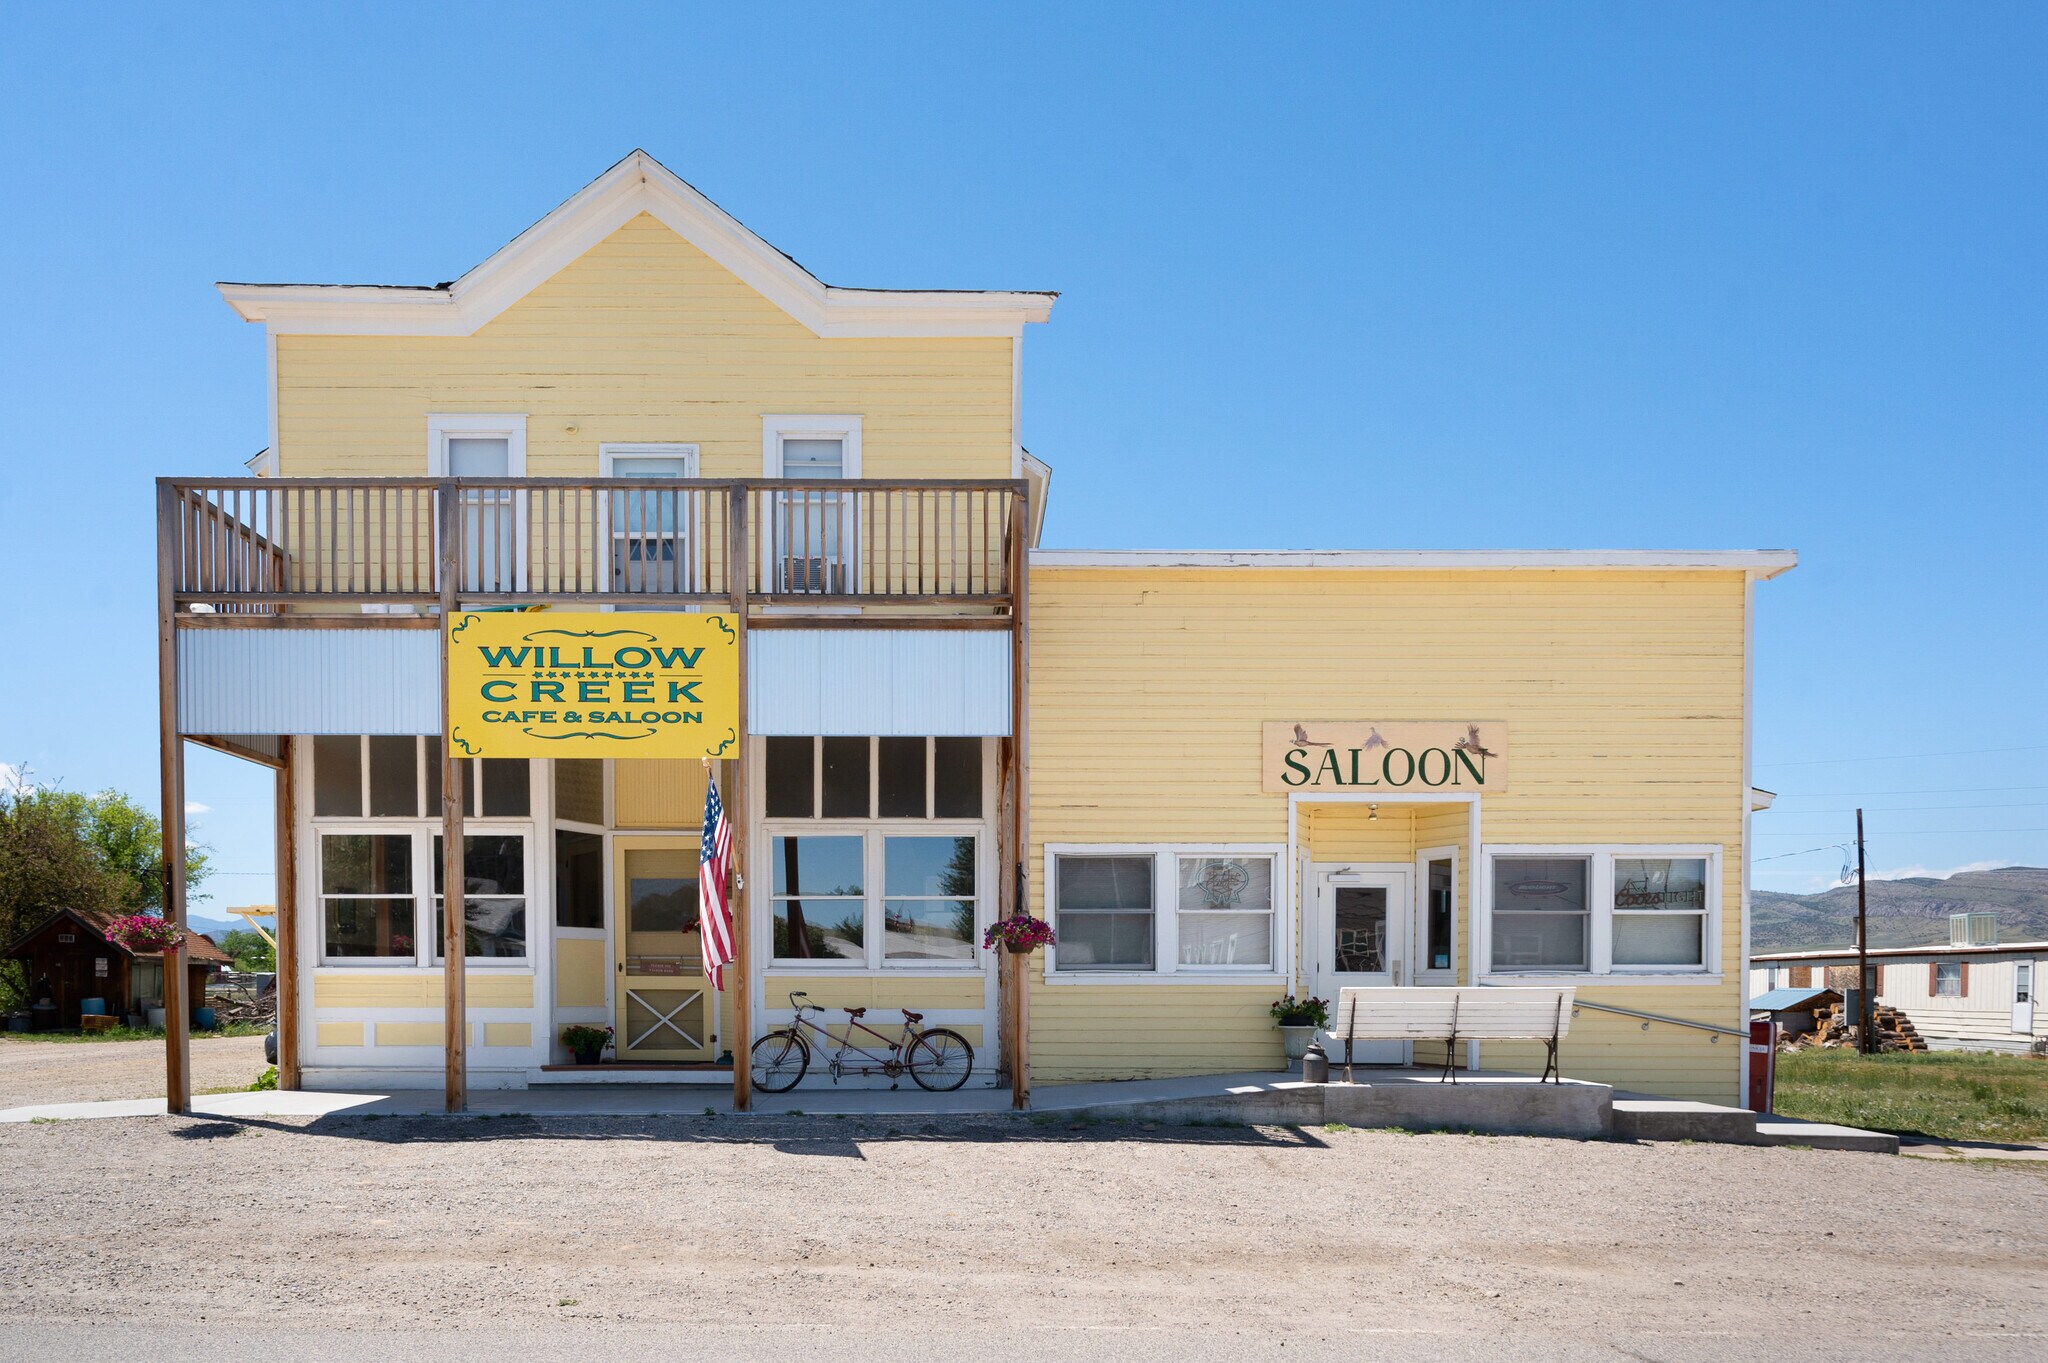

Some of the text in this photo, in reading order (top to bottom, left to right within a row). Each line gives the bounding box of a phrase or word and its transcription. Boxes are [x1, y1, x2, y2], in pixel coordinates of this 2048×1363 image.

[478, 646, 706, 669] WILLOW
[481, 680, 703, 703] CREEK
[482, 710, 703, 724] CAFE & SALOON
[1281, 747, 1489, 787] SALOON
[1615, 888, 1662, 907] Coors
